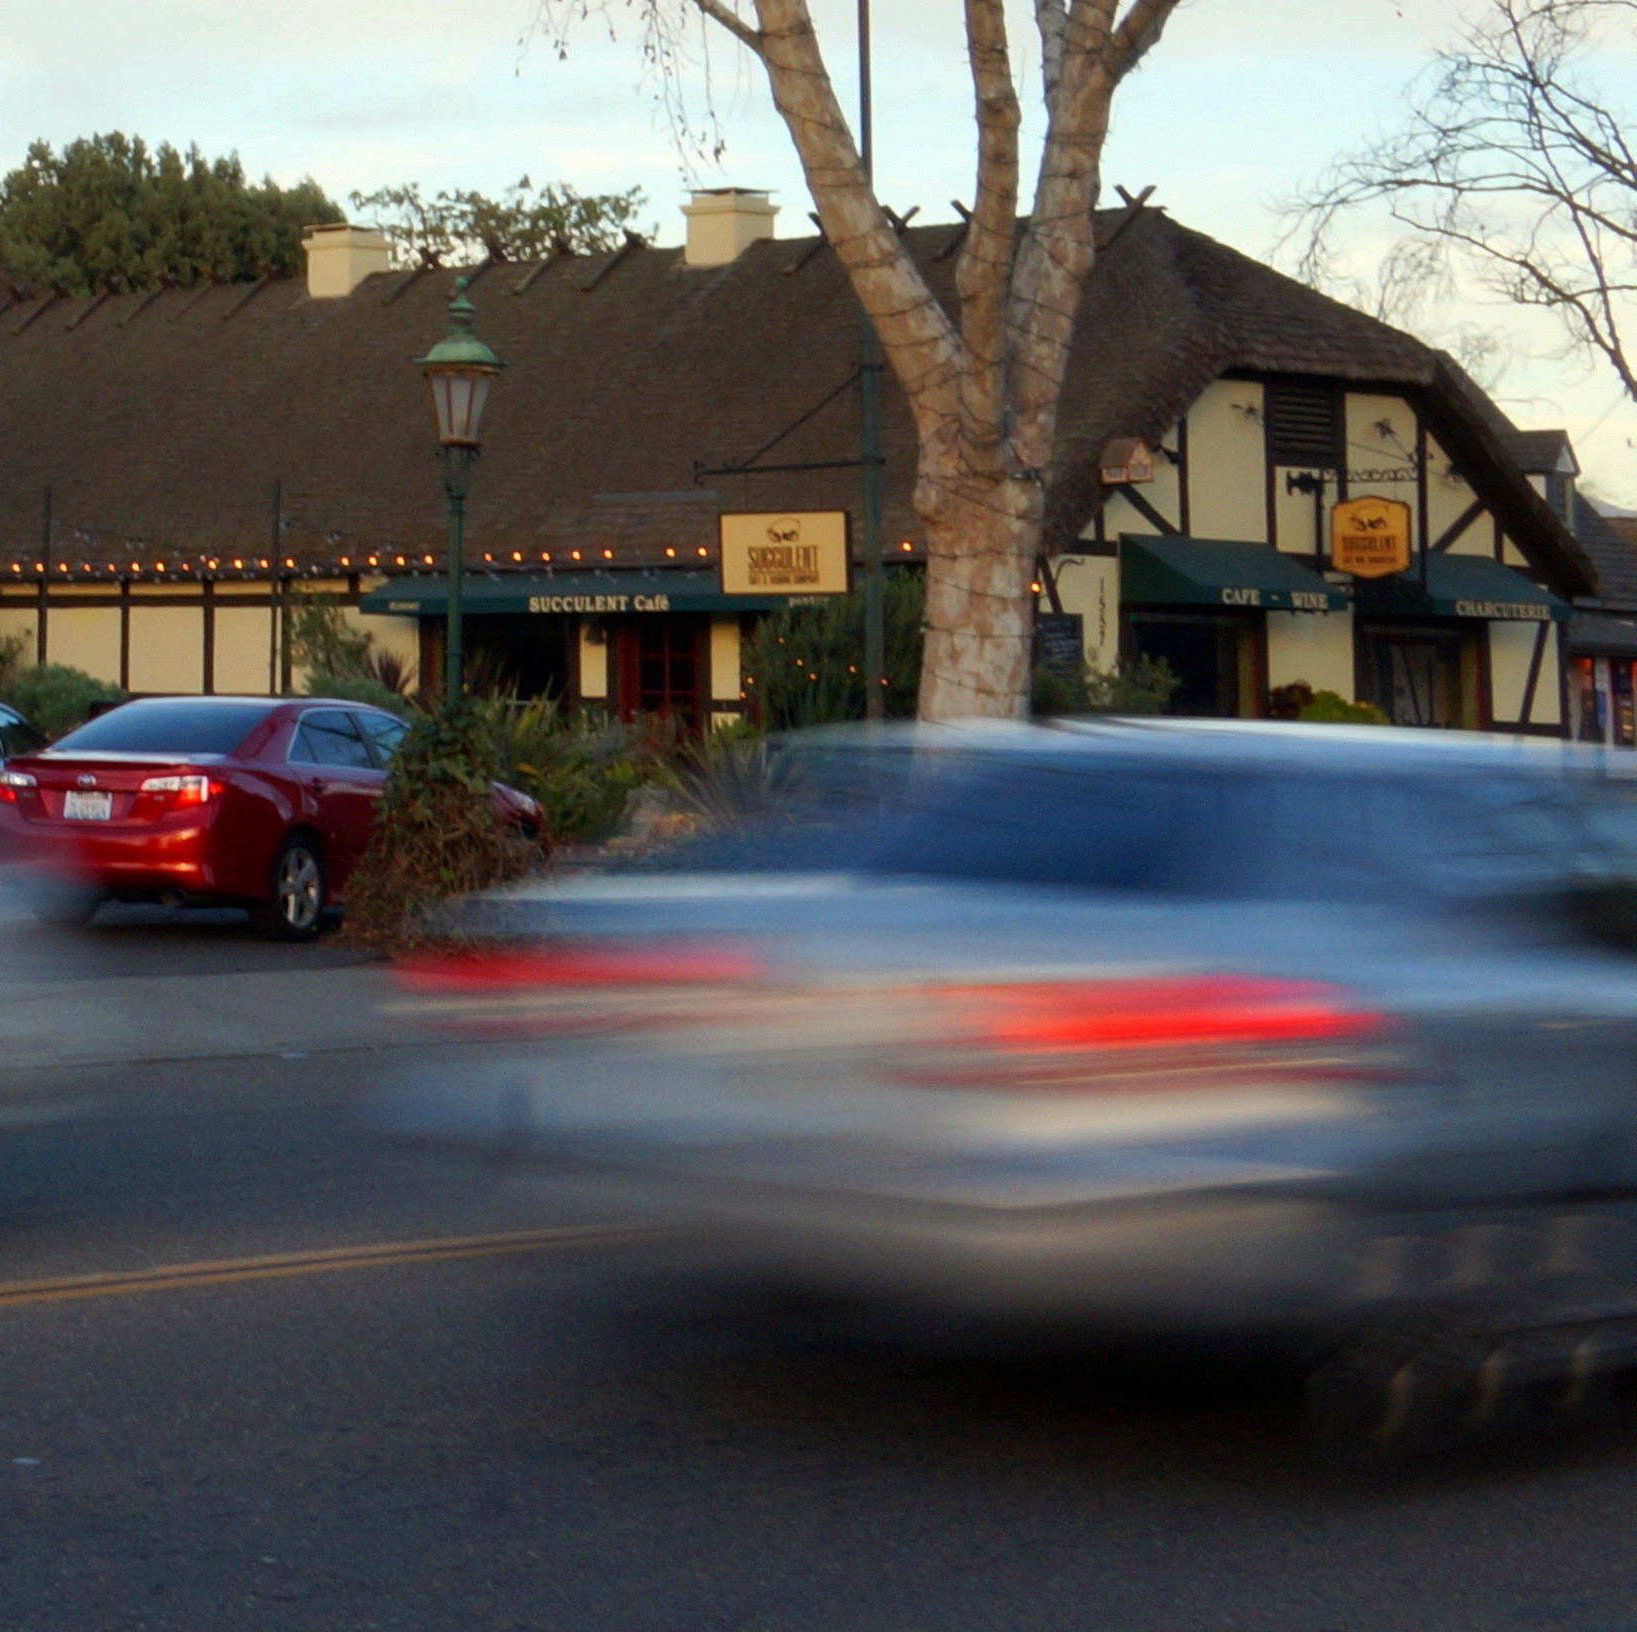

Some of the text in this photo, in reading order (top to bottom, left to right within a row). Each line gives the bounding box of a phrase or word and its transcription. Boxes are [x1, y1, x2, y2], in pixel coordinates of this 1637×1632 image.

[747, 545, 819, 571] SUCCULENT
[528, 593, 670, 613] SUCCULENT Café
[1222, 588, 1261, 606] CAFE
[1290, 590, 1328, 609] WINE
[1455, 599, 1551, 620] CHARCUTERIE
